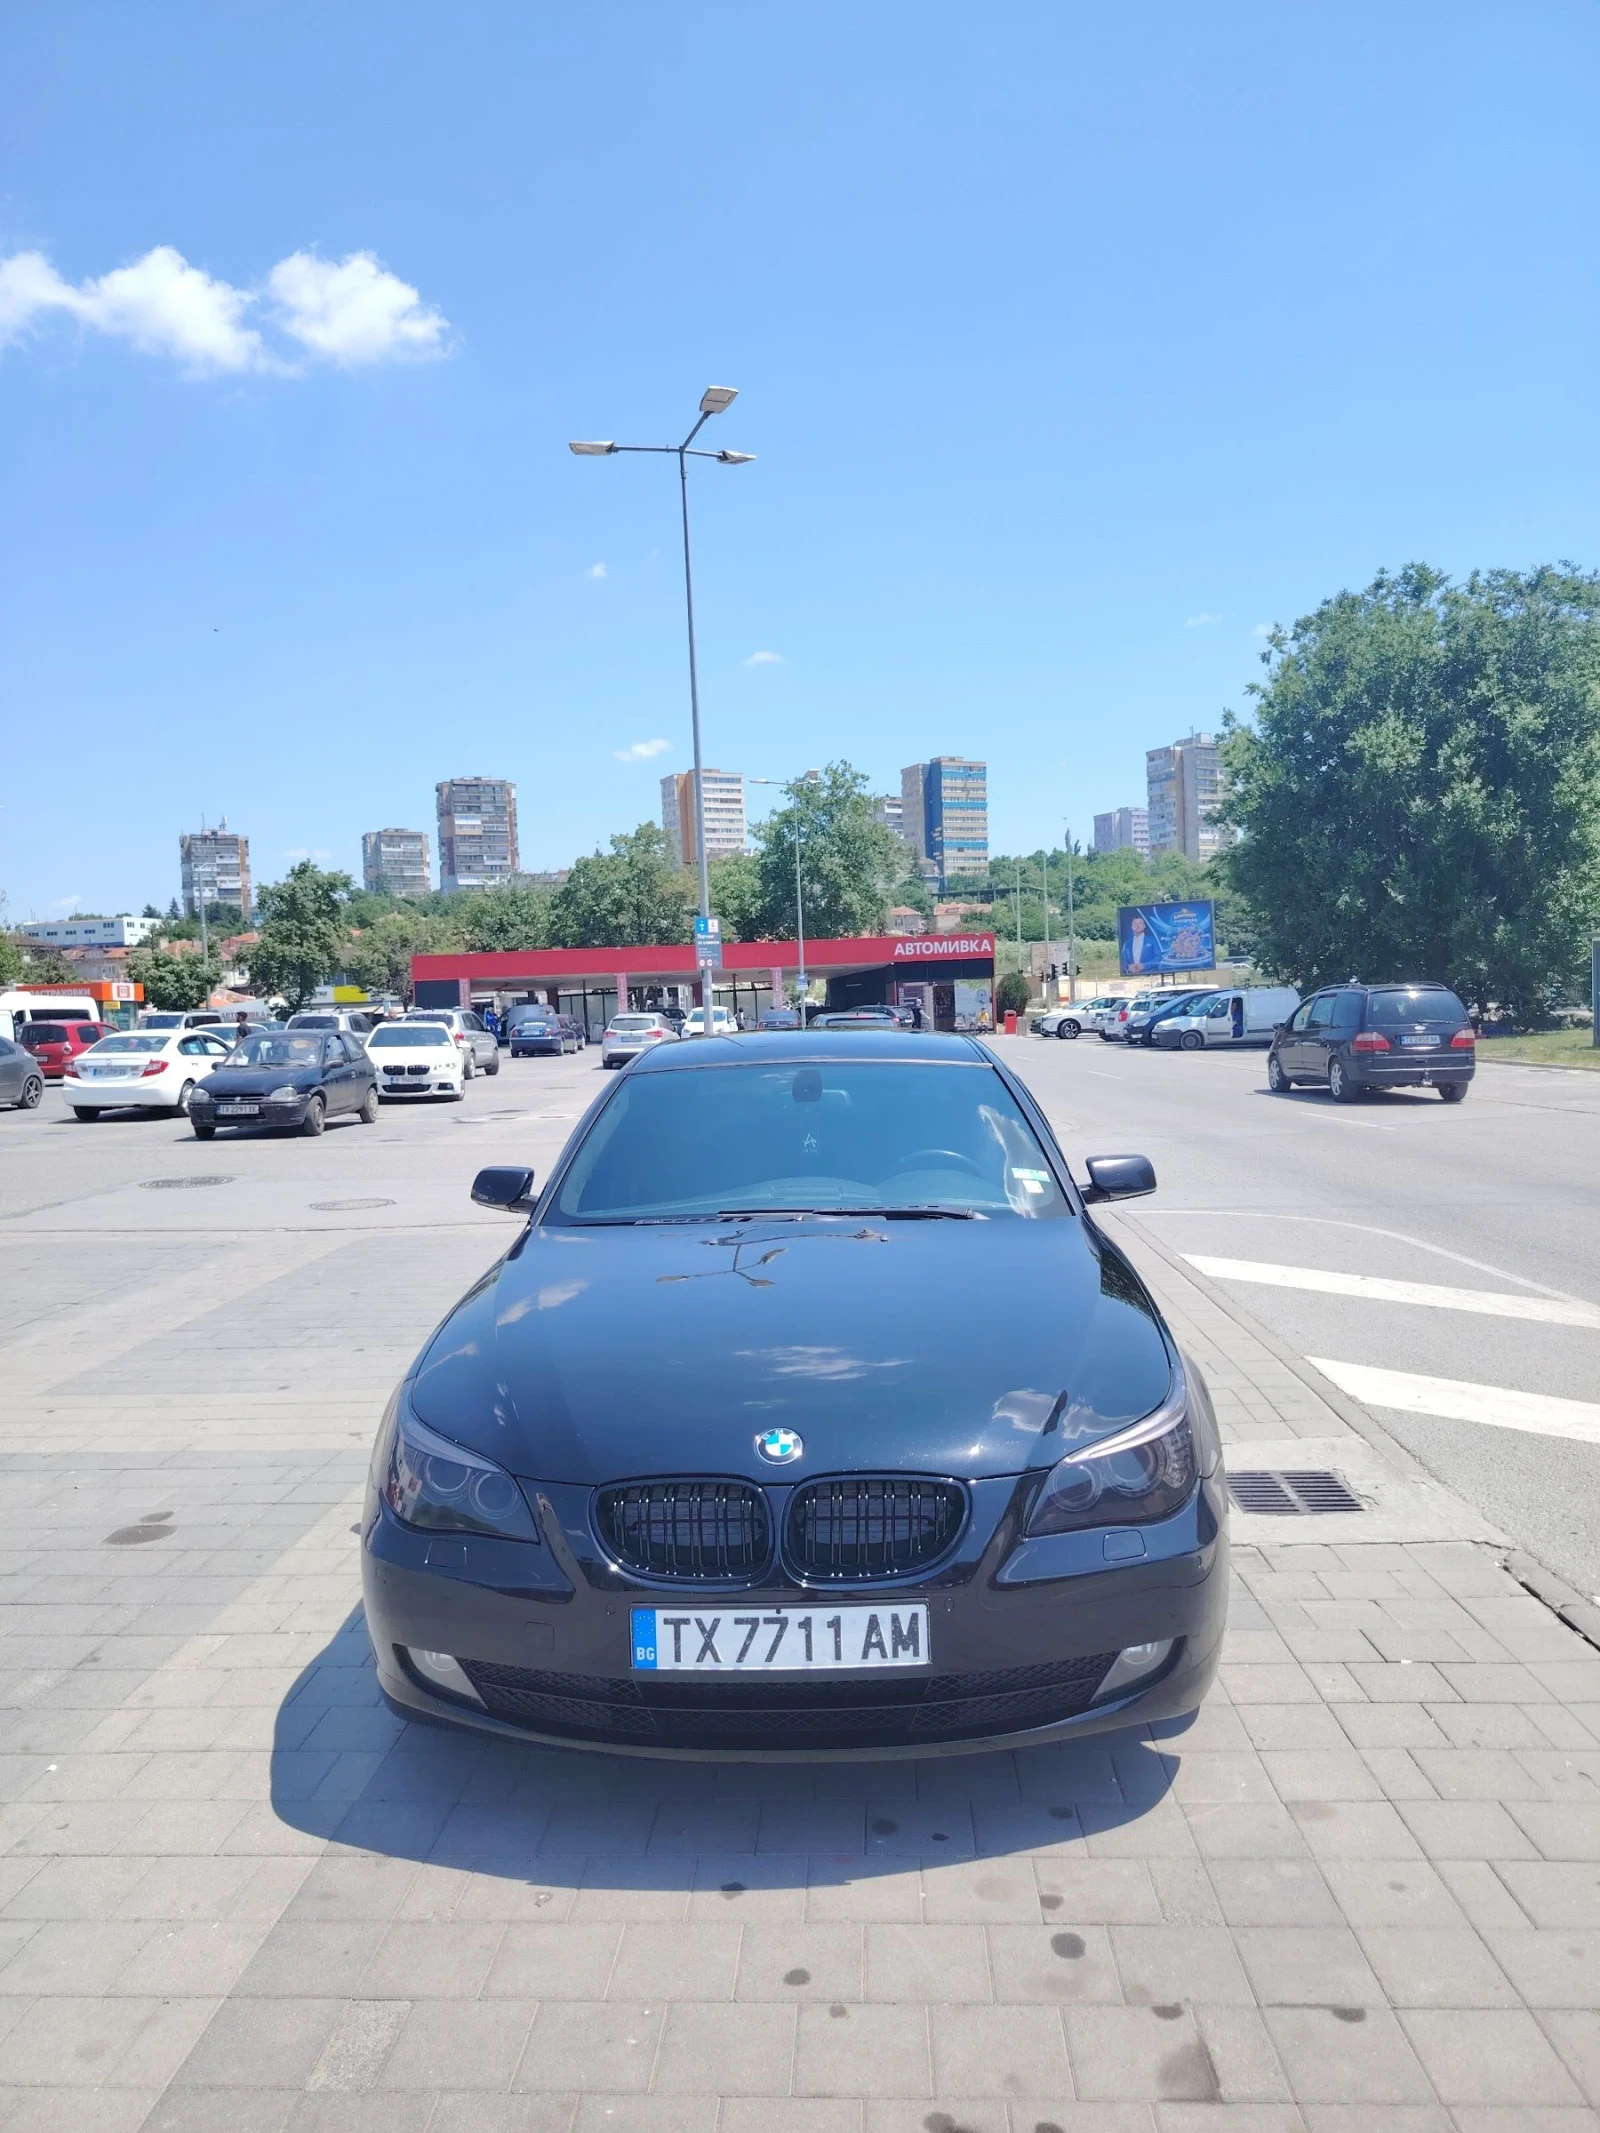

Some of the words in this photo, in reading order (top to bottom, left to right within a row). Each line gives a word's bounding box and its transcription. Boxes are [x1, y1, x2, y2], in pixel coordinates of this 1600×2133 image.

[894, 939, 992, 956] АВТОМИВКА
[663, 1617, 722, 1663] TX
[734, 1615, 842, 1663] 7711
[860, 1612, 920, 1660] AM
[636, 1647, 655, 1660] BG
